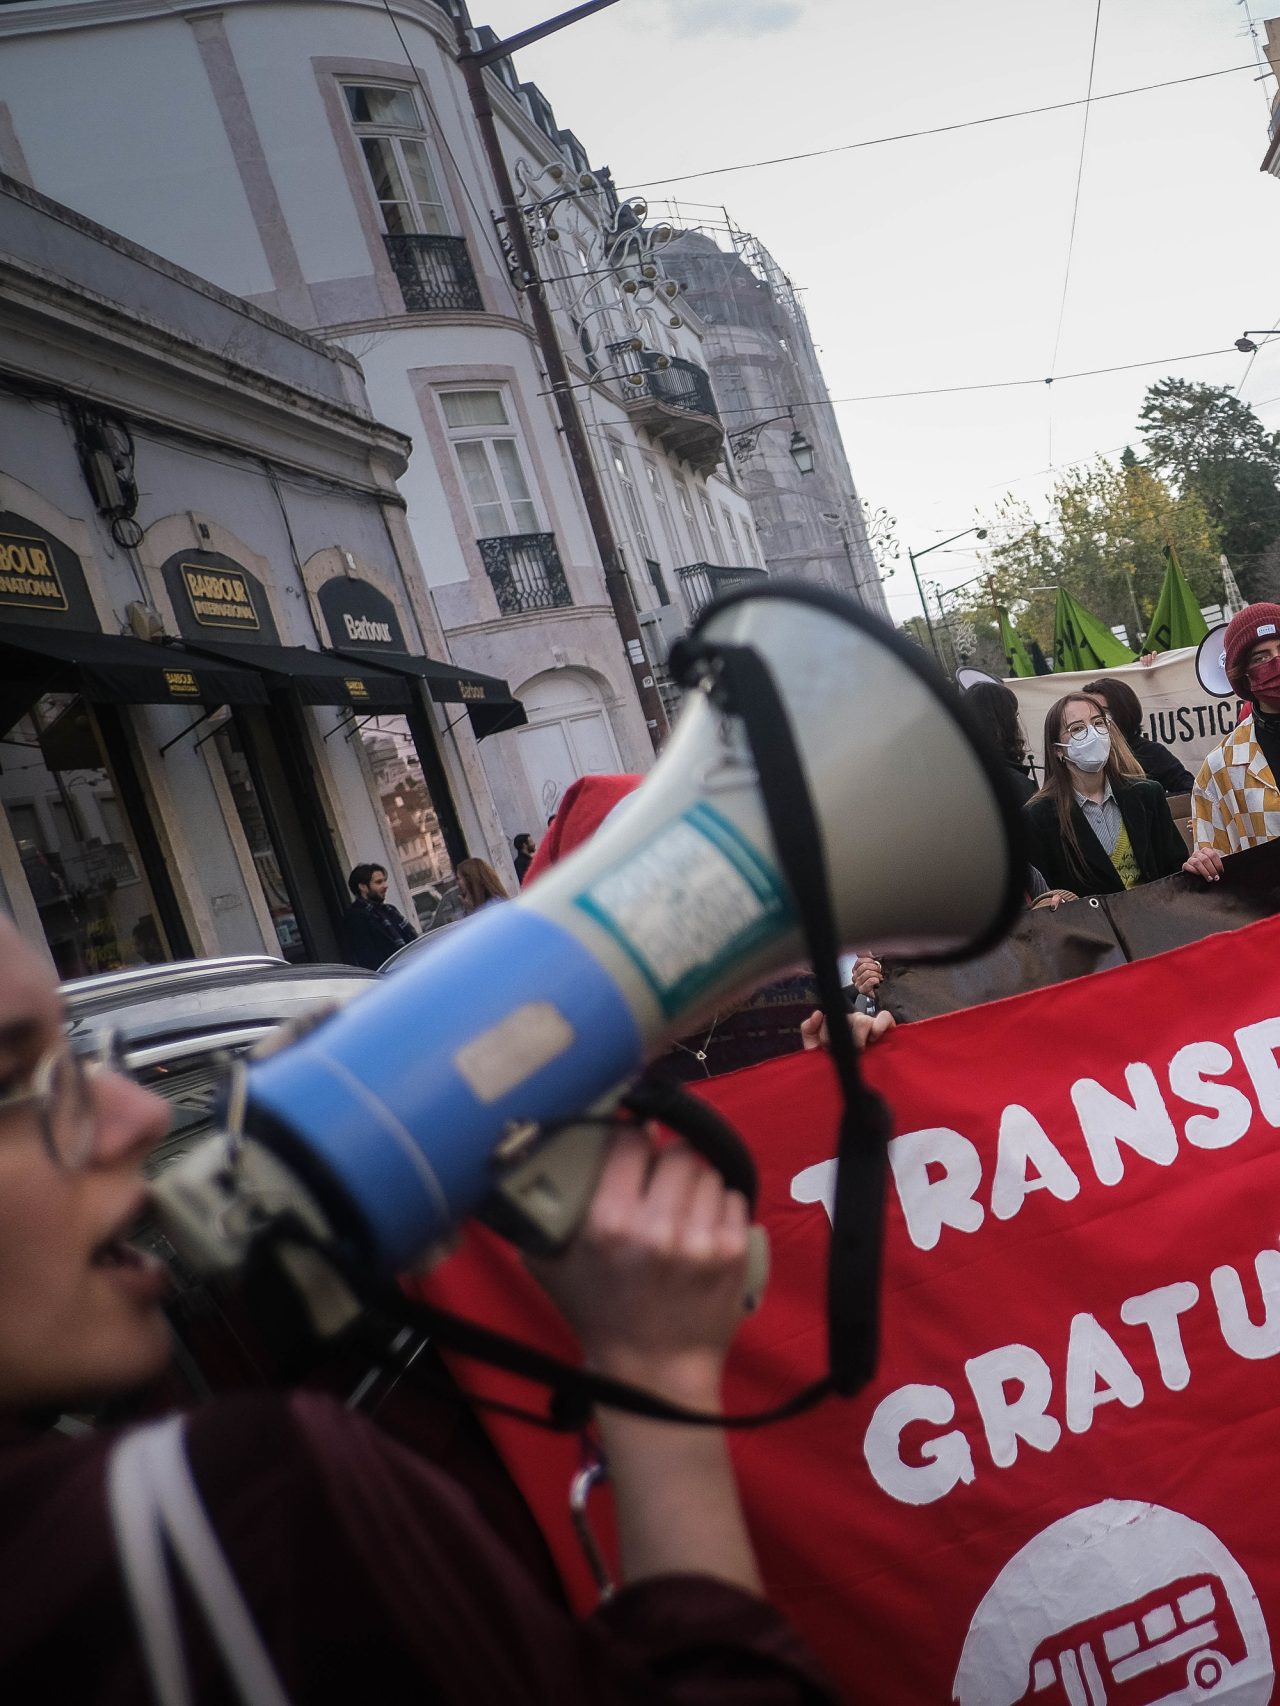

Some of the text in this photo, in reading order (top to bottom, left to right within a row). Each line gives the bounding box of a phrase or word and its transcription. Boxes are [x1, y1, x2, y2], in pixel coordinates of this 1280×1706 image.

[186, 573, 248, 602] BARBOUR
[193, 600, 255, 620] INTERNATIONAL
[343, 613, 392, 642] Barbour
